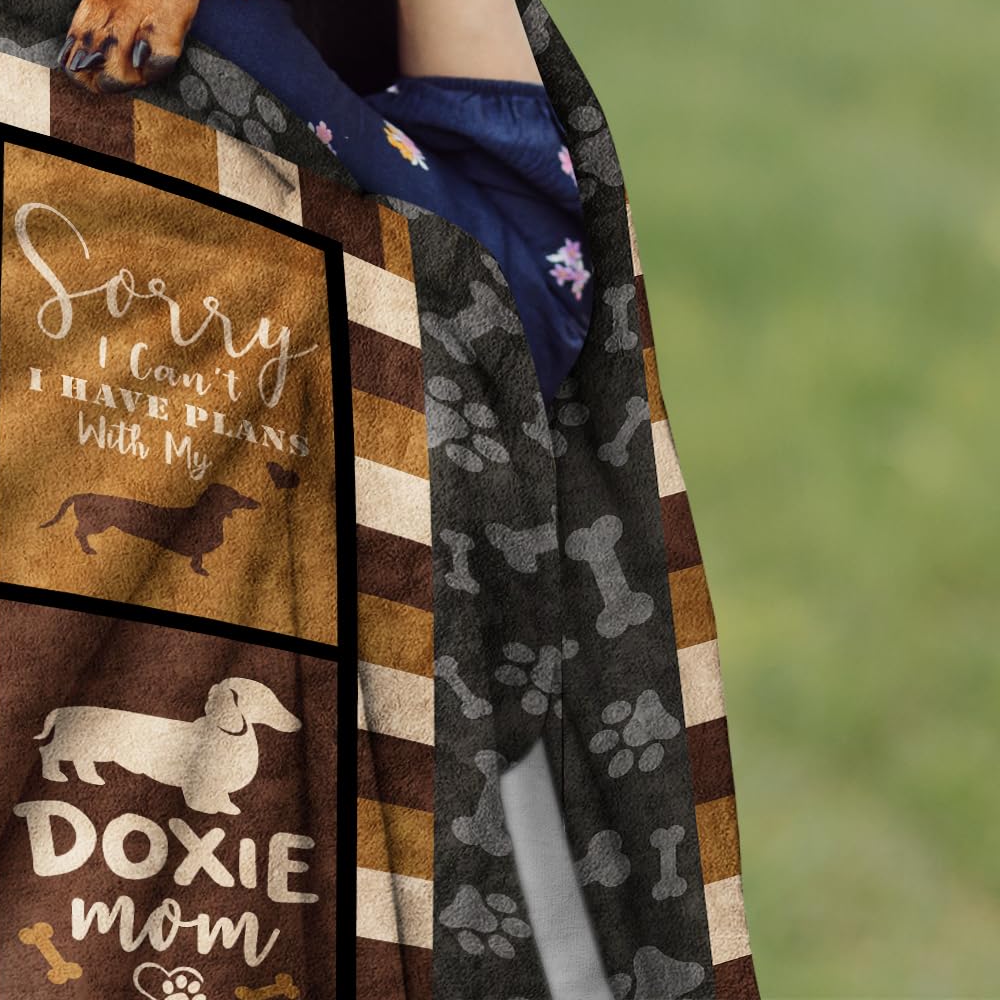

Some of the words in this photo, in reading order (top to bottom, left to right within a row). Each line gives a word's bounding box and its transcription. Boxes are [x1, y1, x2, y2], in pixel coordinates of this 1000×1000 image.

[15, 202, 318, 408] Sorry
[99, 336, 107, 368] I
[130, 342, 241, 401] Can't
[29, 367, 43, 391] I
[61, 374, 169, 421] HAVE
[184, 404, 310, 457] PLANS
[78, 411, 149, 459] With
[165, 431, 213, 480] My
[13, 800, 319, 904] DOXIE
[71, 896, 280, 967] mom
